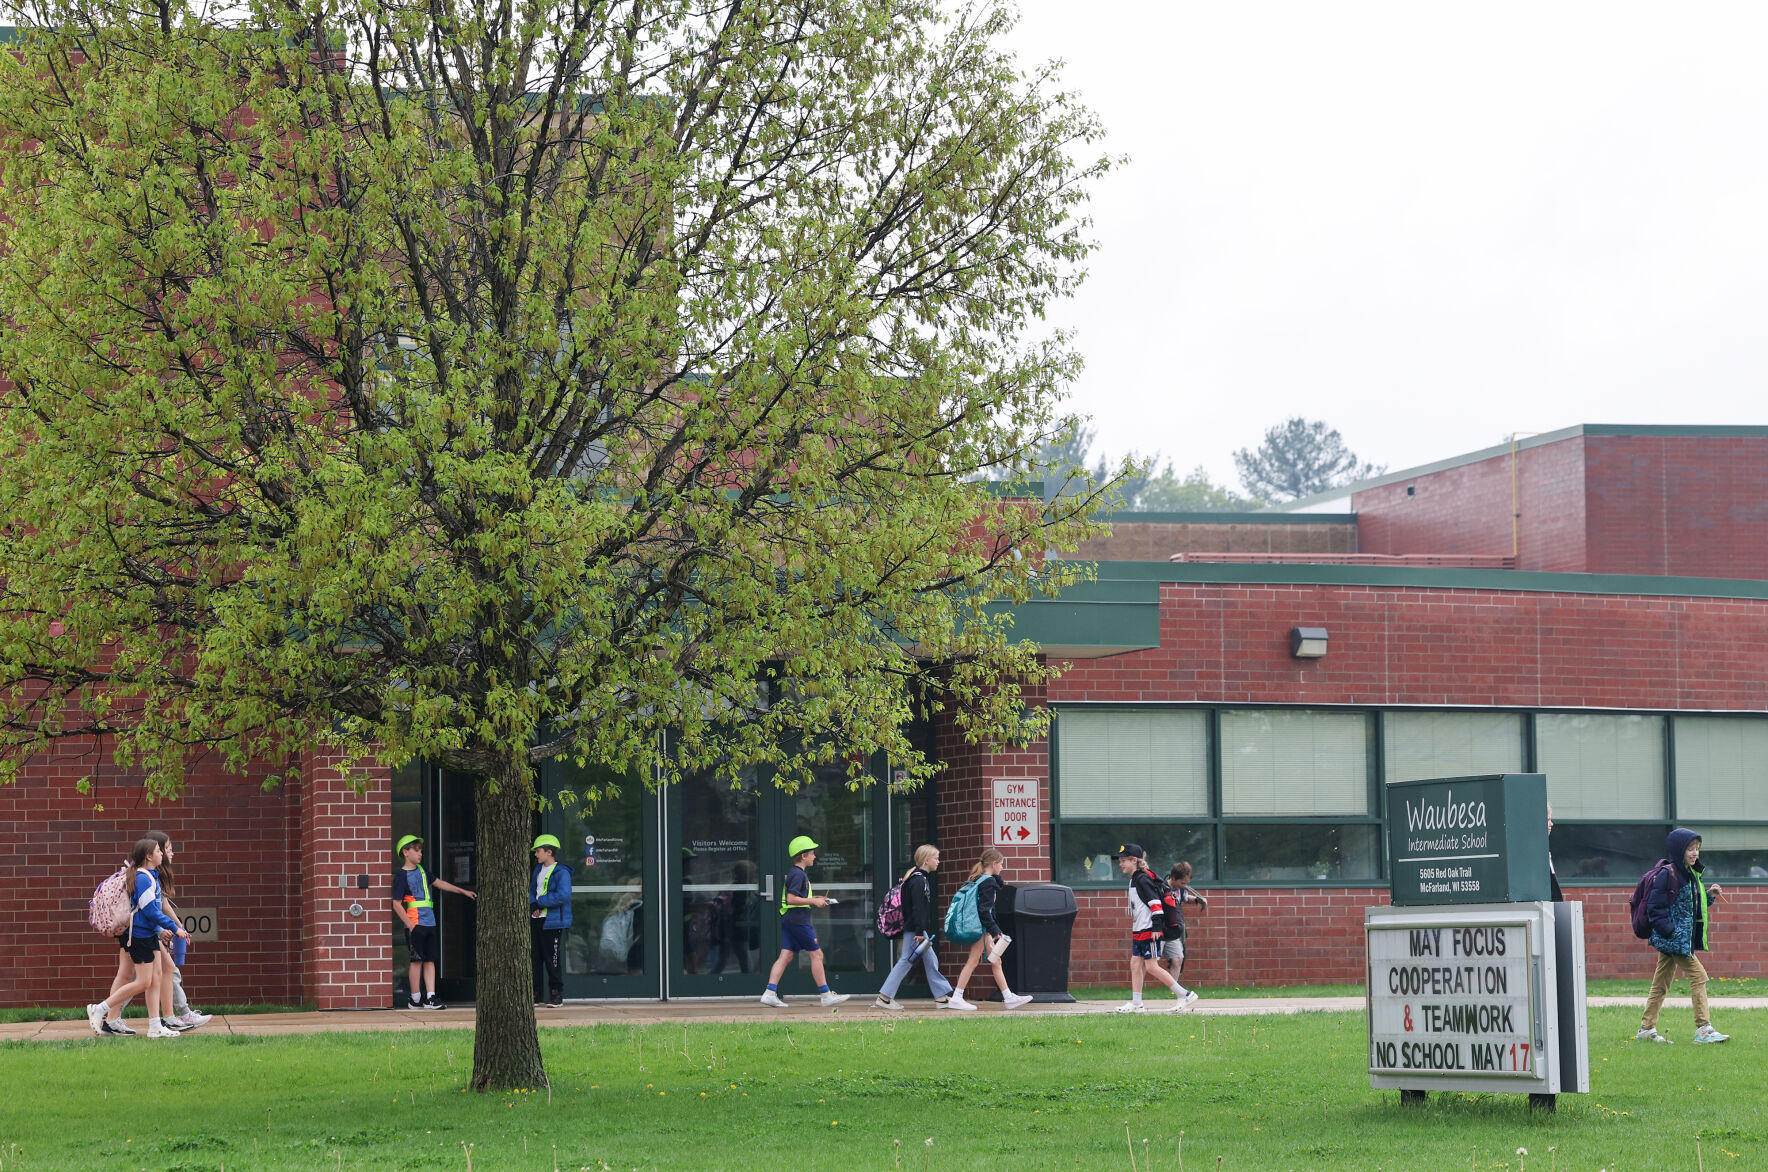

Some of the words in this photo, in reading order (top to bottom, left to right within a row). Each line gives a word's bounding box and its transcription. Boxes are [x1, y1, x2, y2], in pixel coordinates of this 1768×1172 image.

[1007, 784, 1024, 794] GYM
[994, 798, 1036, 807] ENTRANCE
[1406, 789, 1487, 832] Waubesa
[1004, 812, 1027, 821] DOOR
[1000, 826, 1012, 841] K
[1408, 833, 1459, 852] Intermediate
[1461, 831, 1487, 849] School
[1420, 868, 1435, 879] 5605
[1435, 868, 1447, 878] Red
[1447, 867, 1459, 878] Oak
[1459, 866, 1472, 878] Trail
[1420, 881, 1452, 894] McFarland,
[1452, 881, 1460, 892] WI
[1460, 880, 1480, 892] 53558
[177, 915, 211, 933] 00
[1409, 928, 1441, 957] MAY
[1453, 928, 1506, 957] FOCUS
[1389, 966, 1507, 995] COOPERATION
[1403, 1004, 1414, 1032] &
[1421, 1004, 1514, 1035] TEAMWORK
[1376, 1041, 1397, 1068] NO
[1401, 1041, 1465, 1069] SCHOOL
[1471, 1043, 1506, 1070] MAY
[1509, 1043, 1530, 1071] 17
